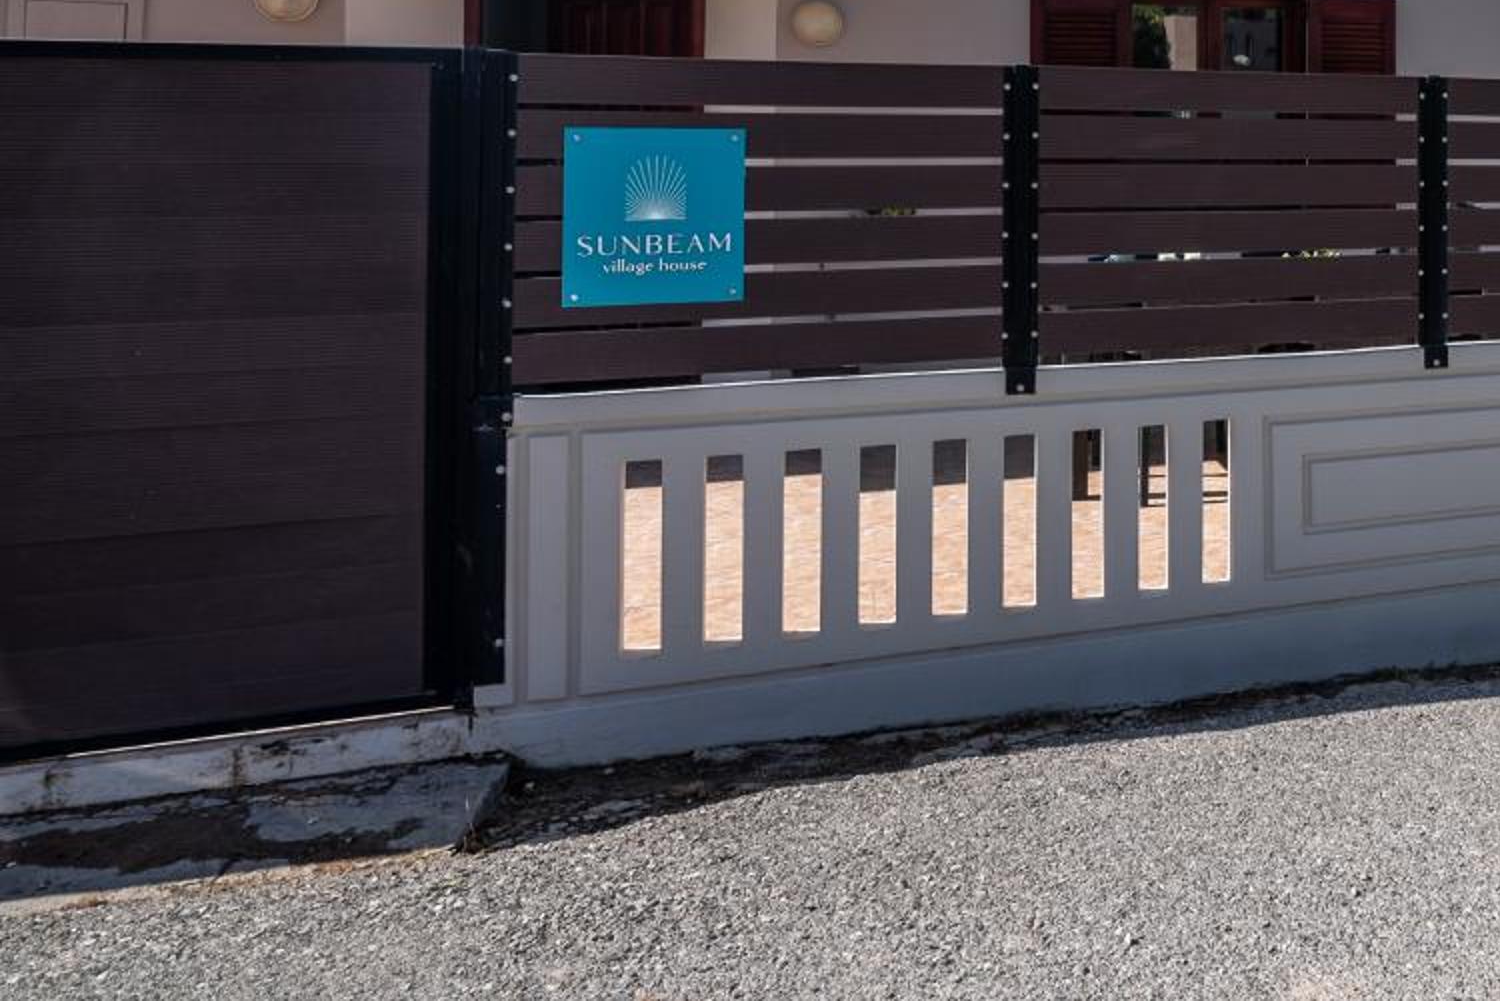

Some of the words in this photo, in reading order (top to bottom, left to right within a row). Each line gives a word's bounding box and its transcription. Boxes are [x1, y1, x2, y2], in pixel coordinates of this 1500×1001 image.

[577, 232, 732, 258] SUNBEAM
[603, 258, 653, 276] village
[659, 257, 707, 272] house
